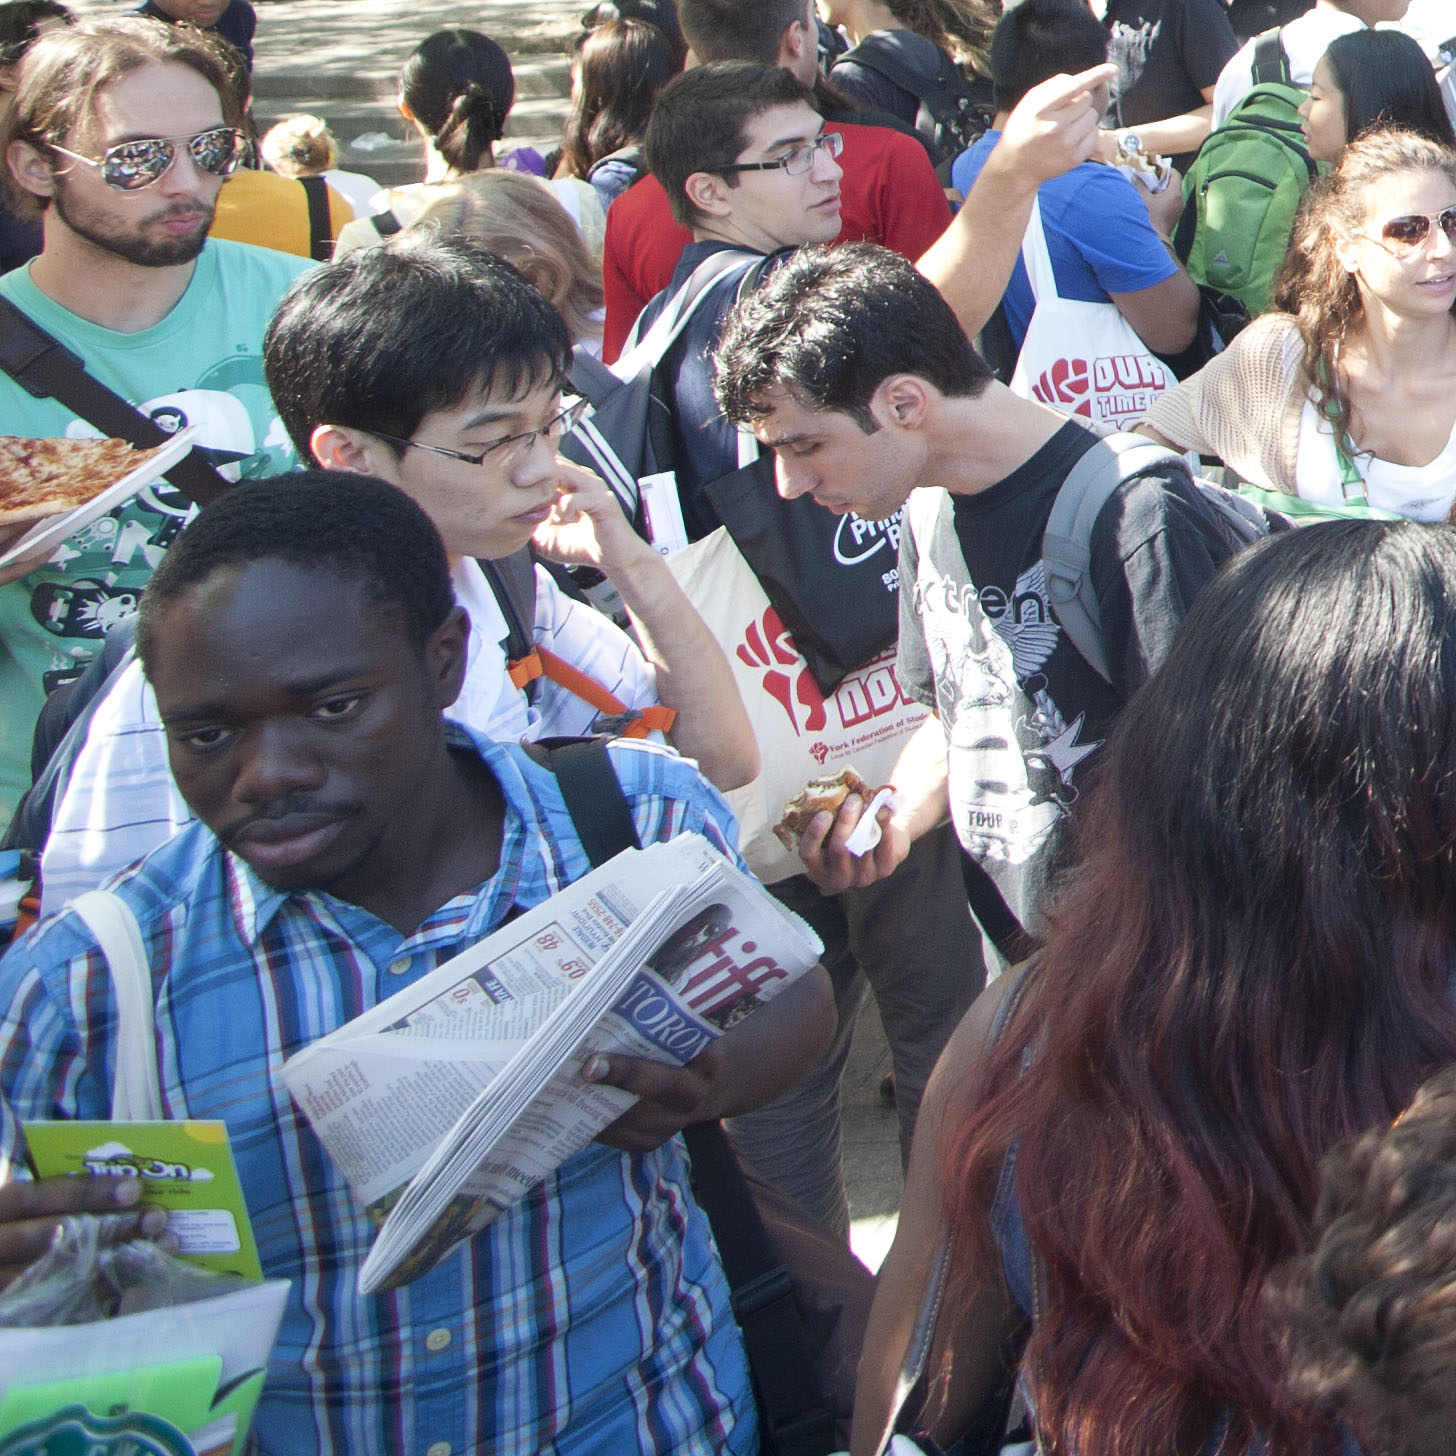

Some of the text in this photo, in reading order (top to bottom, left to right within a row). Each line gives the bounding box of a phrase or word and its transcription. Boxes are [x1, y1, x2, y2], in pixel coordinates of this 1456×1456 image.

[1093, 354, 1166, 392] OUR
[1097, 392, 1147, 418] TIME
[829, 742, 849, 752] York
[851, 725, 894, 745] Federation
[896, 719, 904, 728] of
[906, 713, 928, 724] Stude
[536, 933, 559, 952] 48
[678, 926, 789, 1018] tiff
[622, 980, 712, 1060] TORON
